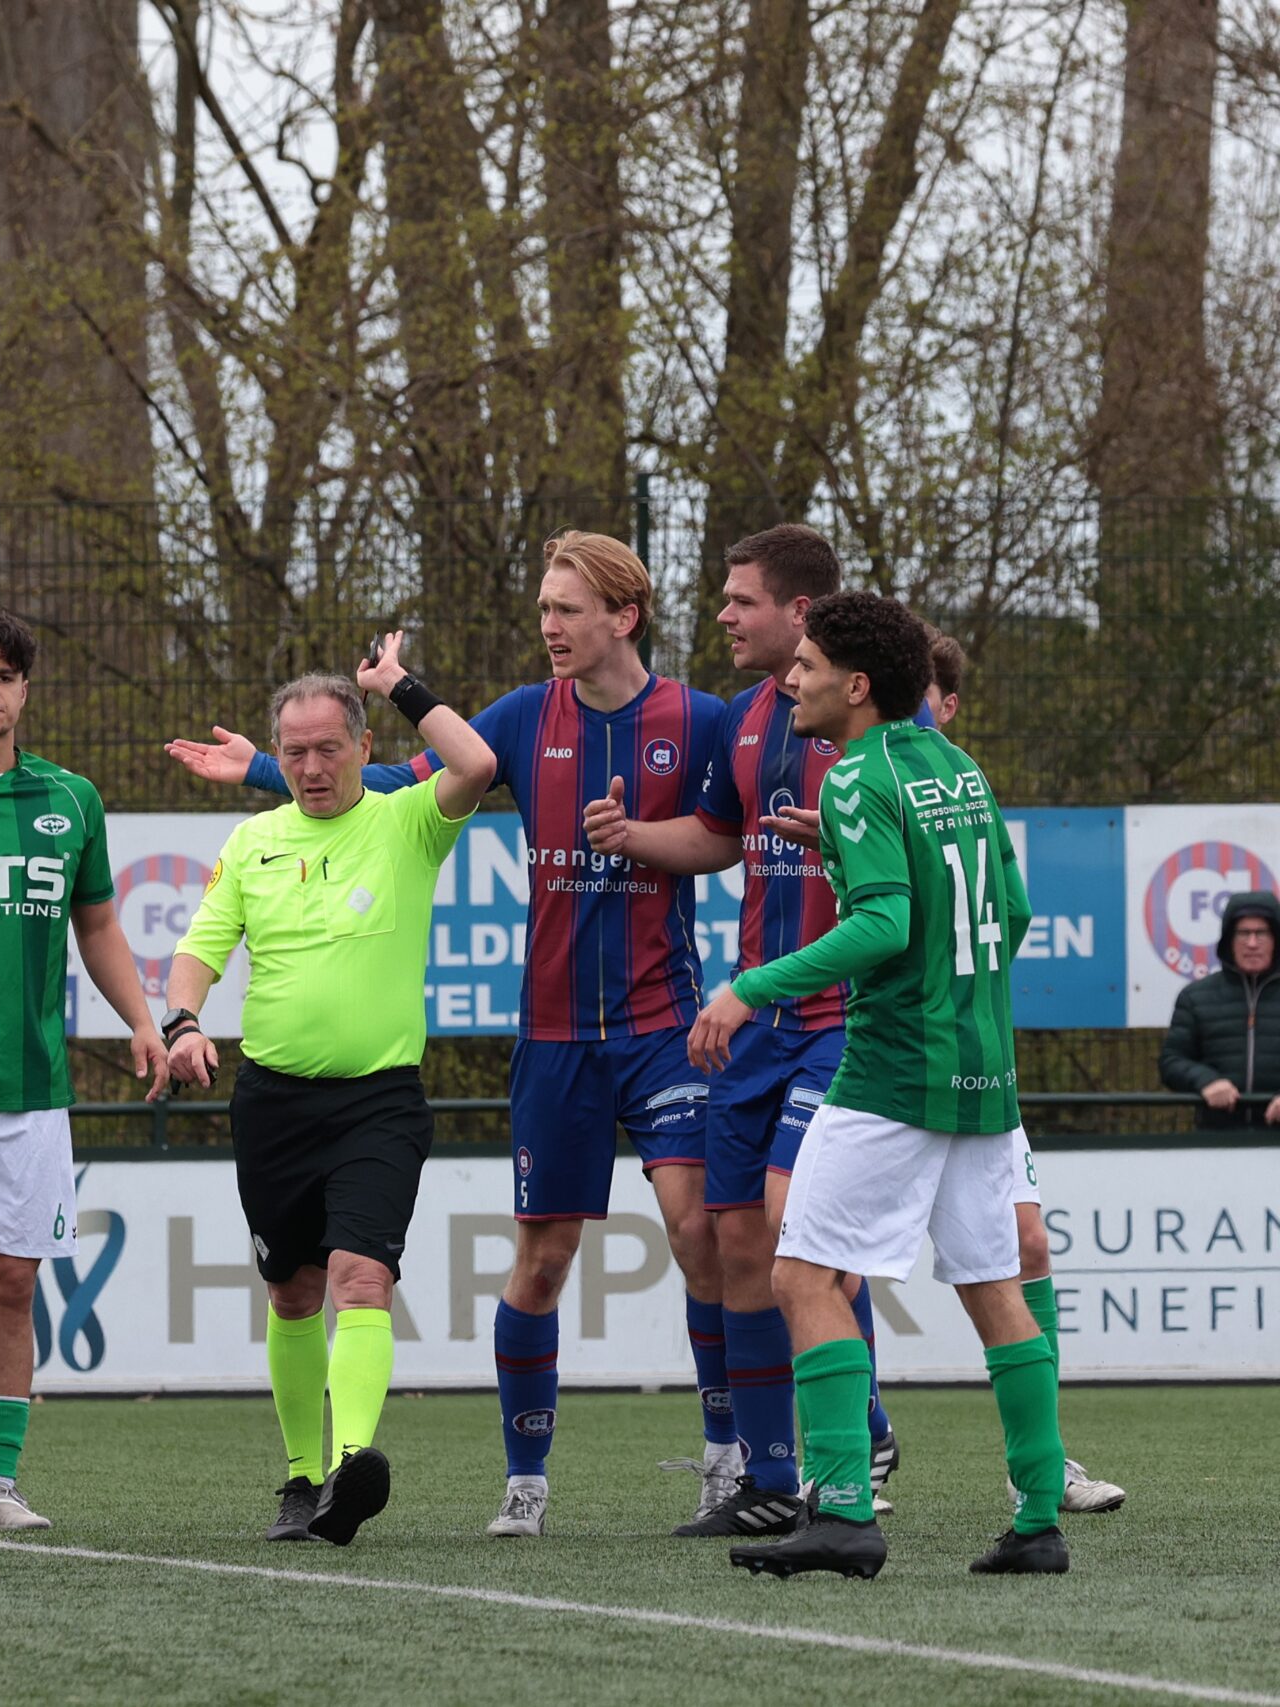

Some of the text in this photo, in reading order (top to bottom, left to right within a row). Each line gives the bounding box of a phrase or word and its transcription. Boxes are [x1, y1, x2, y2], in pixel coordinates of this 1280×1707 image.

[738, 733, 760, 747] JAKO
[543, 746, 573, 759] JAKO
[916, 803, 964, 820] PERSONAL
[547, 875, 659, 895] uitzendbureau
[942, 837, 1002, 976] 14
[143, 903, 187, 936] FC
[951, 1074, 1001, 1090] RODA
[1024, 1151, 1038, 1187] 8
[52, 1202, 66, 1241] 6
